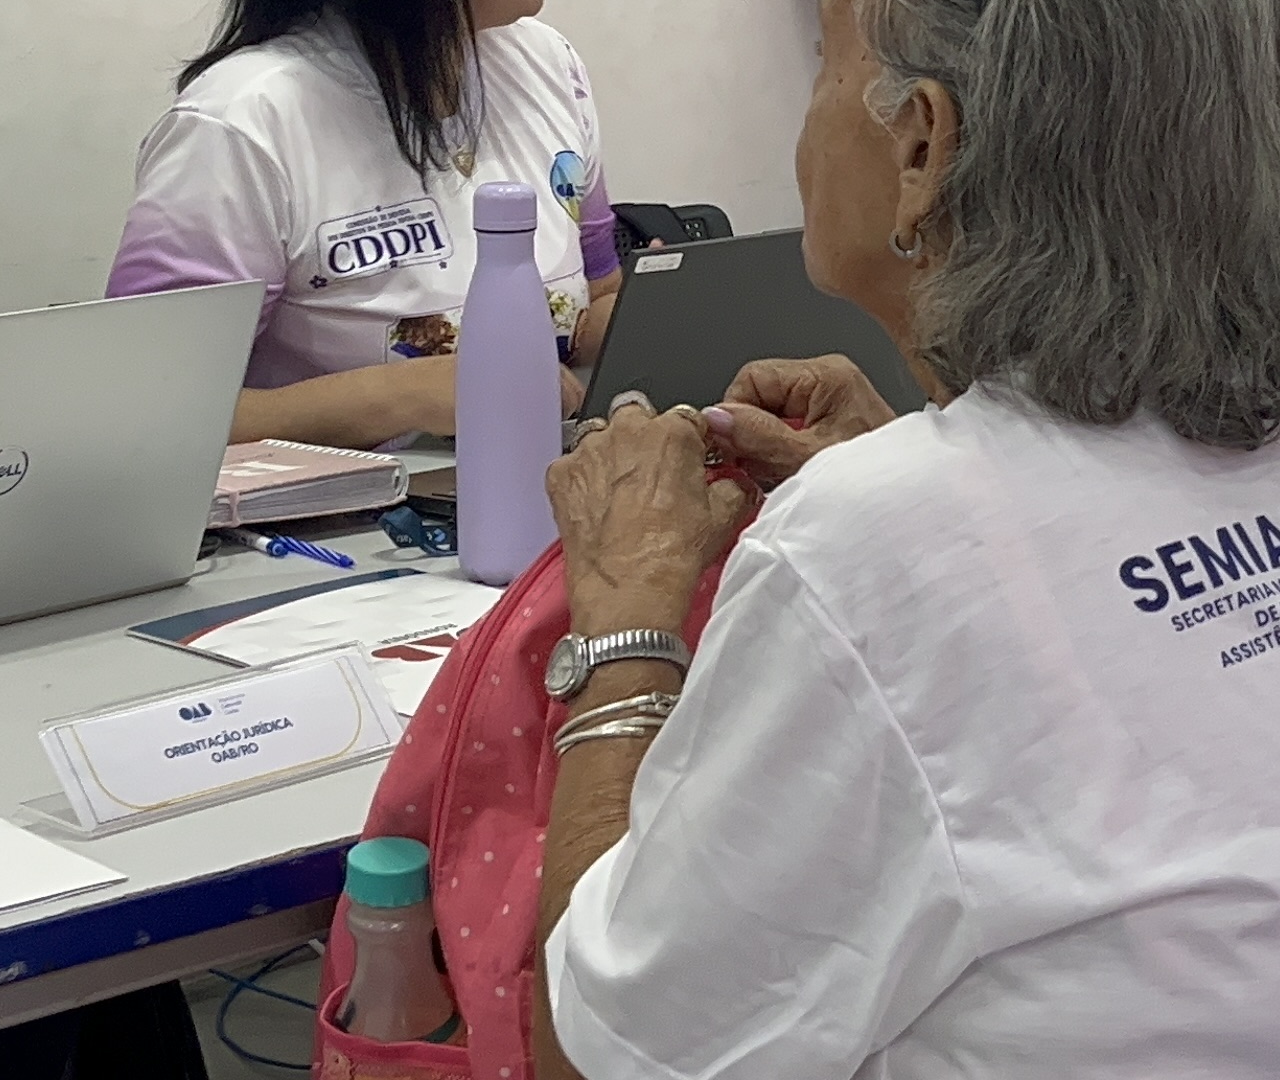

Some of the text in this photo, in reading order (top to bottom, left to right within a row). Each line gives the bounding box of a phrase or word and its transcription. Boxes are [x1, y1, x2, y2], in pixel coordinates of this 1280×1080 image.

[328, 219, 445, 273] CDDPI
[1171, 583, 1275, 632] SECRETARIA
[1254, 605, 1280, 627] DE
[164, 717, 293, 759] ORIENTAÇÃO JURÍDICA
[211, 742, 259, 763] OAB/RO
